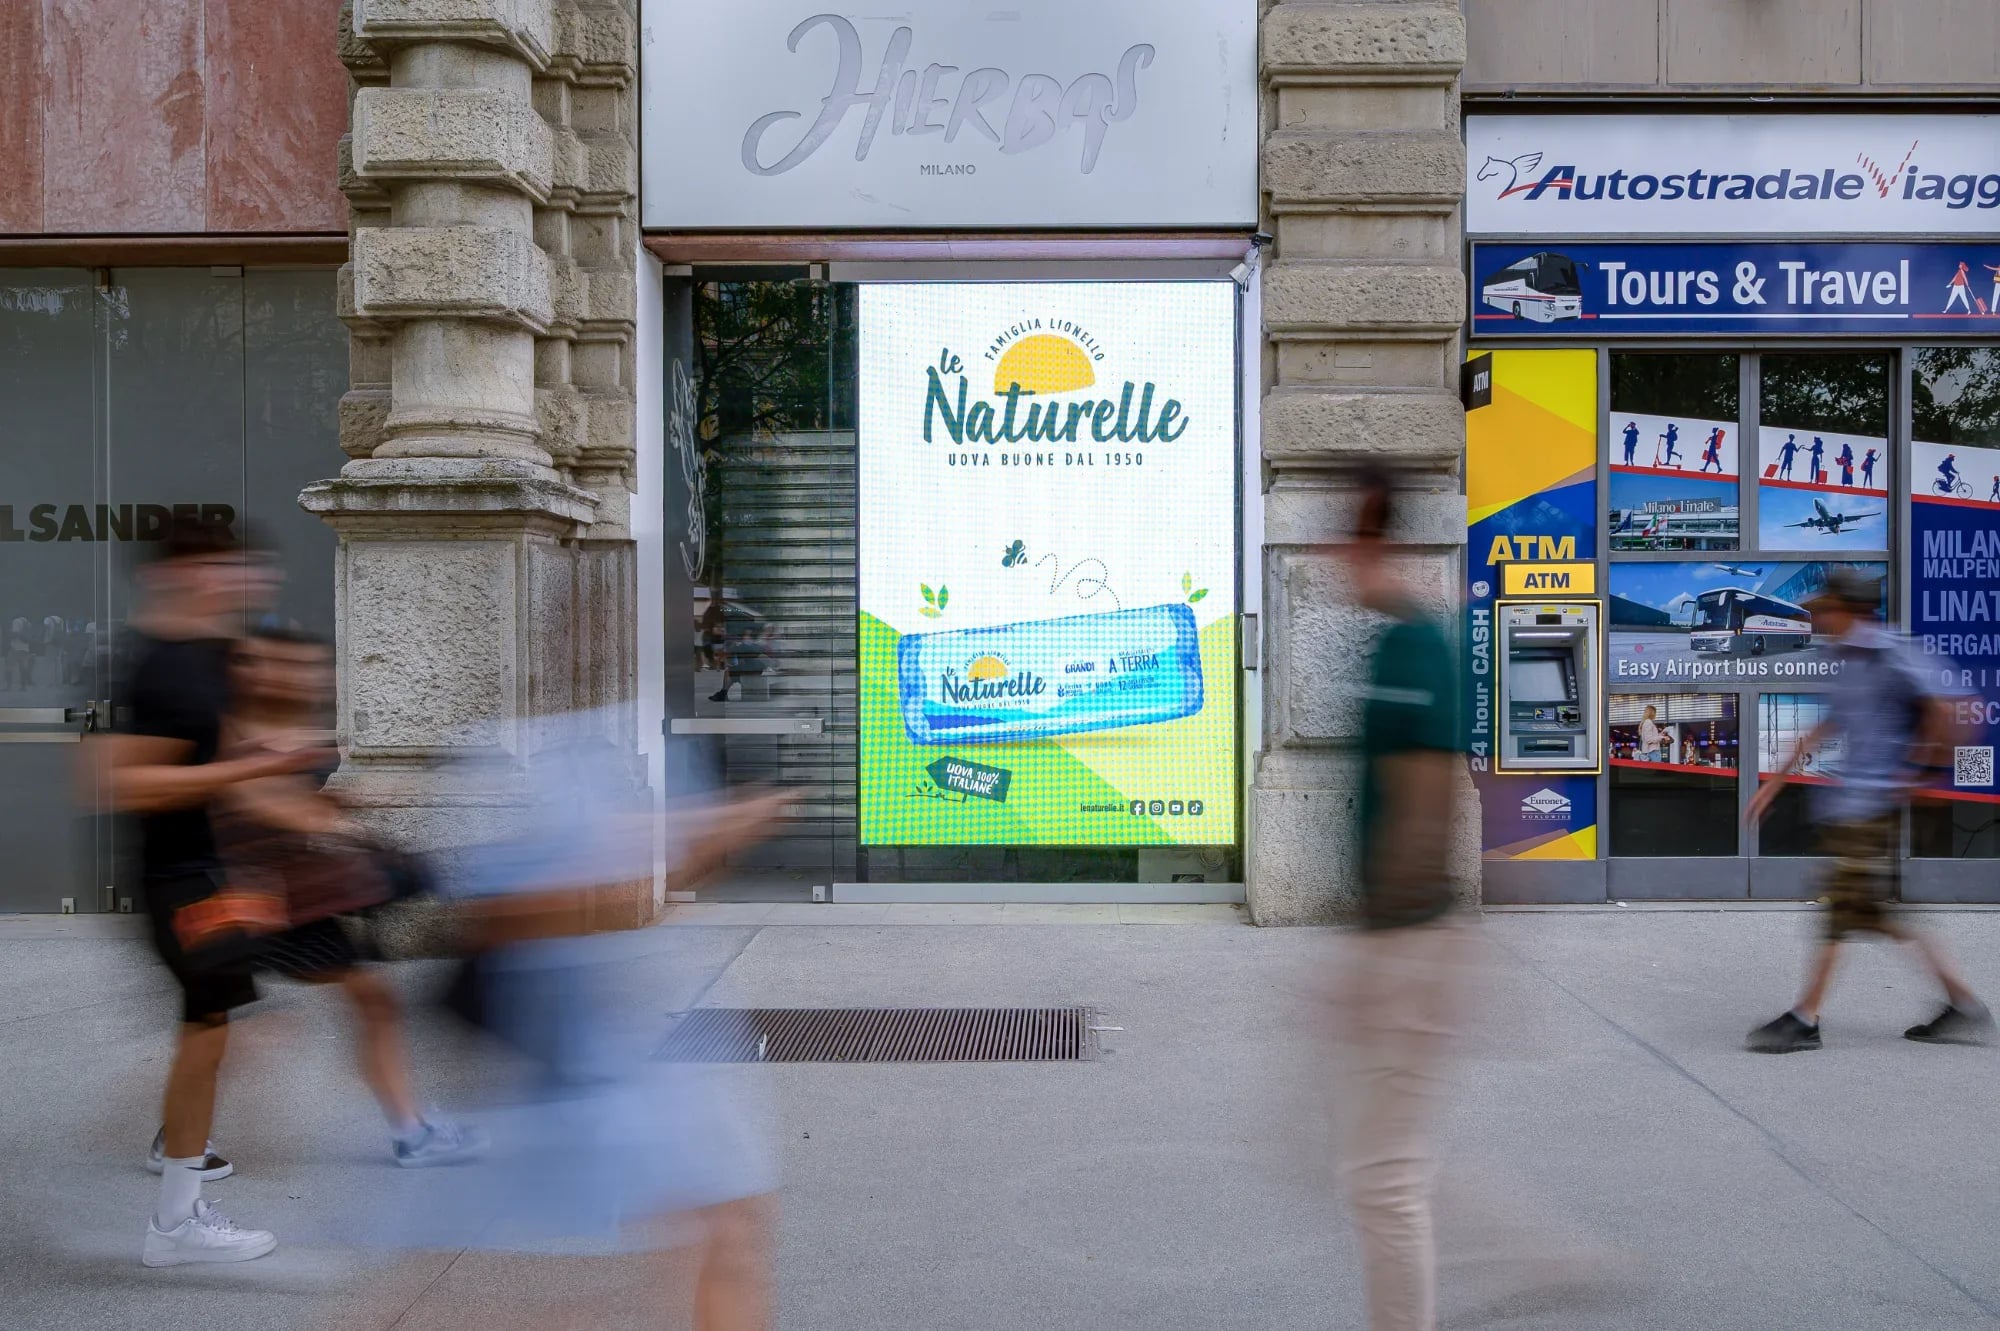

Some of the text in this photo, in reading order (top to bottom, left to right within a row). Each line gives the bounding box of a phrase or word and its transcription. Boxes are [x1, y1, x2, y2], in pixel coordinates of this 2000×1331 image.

[919, 164, 977, 176] MILANO
[1523, 165, 1865, 200] Autostradale
[1599, 259, 1909, 305] Tours & Travel
[984, 318, 1105, 361] FAMIGLIA LIONELLO
[940, 347, 964, 374] le
[1473, 370, 1489, 392] ATM
[923, 365, 1189, 445] Naturelle
[949, 453, 1143, 466] UOVA BUONE DAL 1950
[1641, 499, 1714, 513] Milano Linate
[1486, 535, 1575, 566] ATM
[1524, 573, 1570, 589] ATM
[1065, 662, 1095, 674] GRANDI
[1109, 654, 1160, 673] A TERRA
[1618, 659, 1661, 679] Easy
[1665, 659, 1730, 679] Airport
[1736, 658, 1768, 676] bus
[941, 672, 1046, 704] Naturelle
[1472, 609, 1489, 772] 24 hour CASH
[947, 763, 1000, 785] UOVA 100%
[948, 775, 993, 795] ITALIANE
[1080, 803, 1125, 813] lenaturelle.it
[1530, 796, 1563, 805] Euronet
